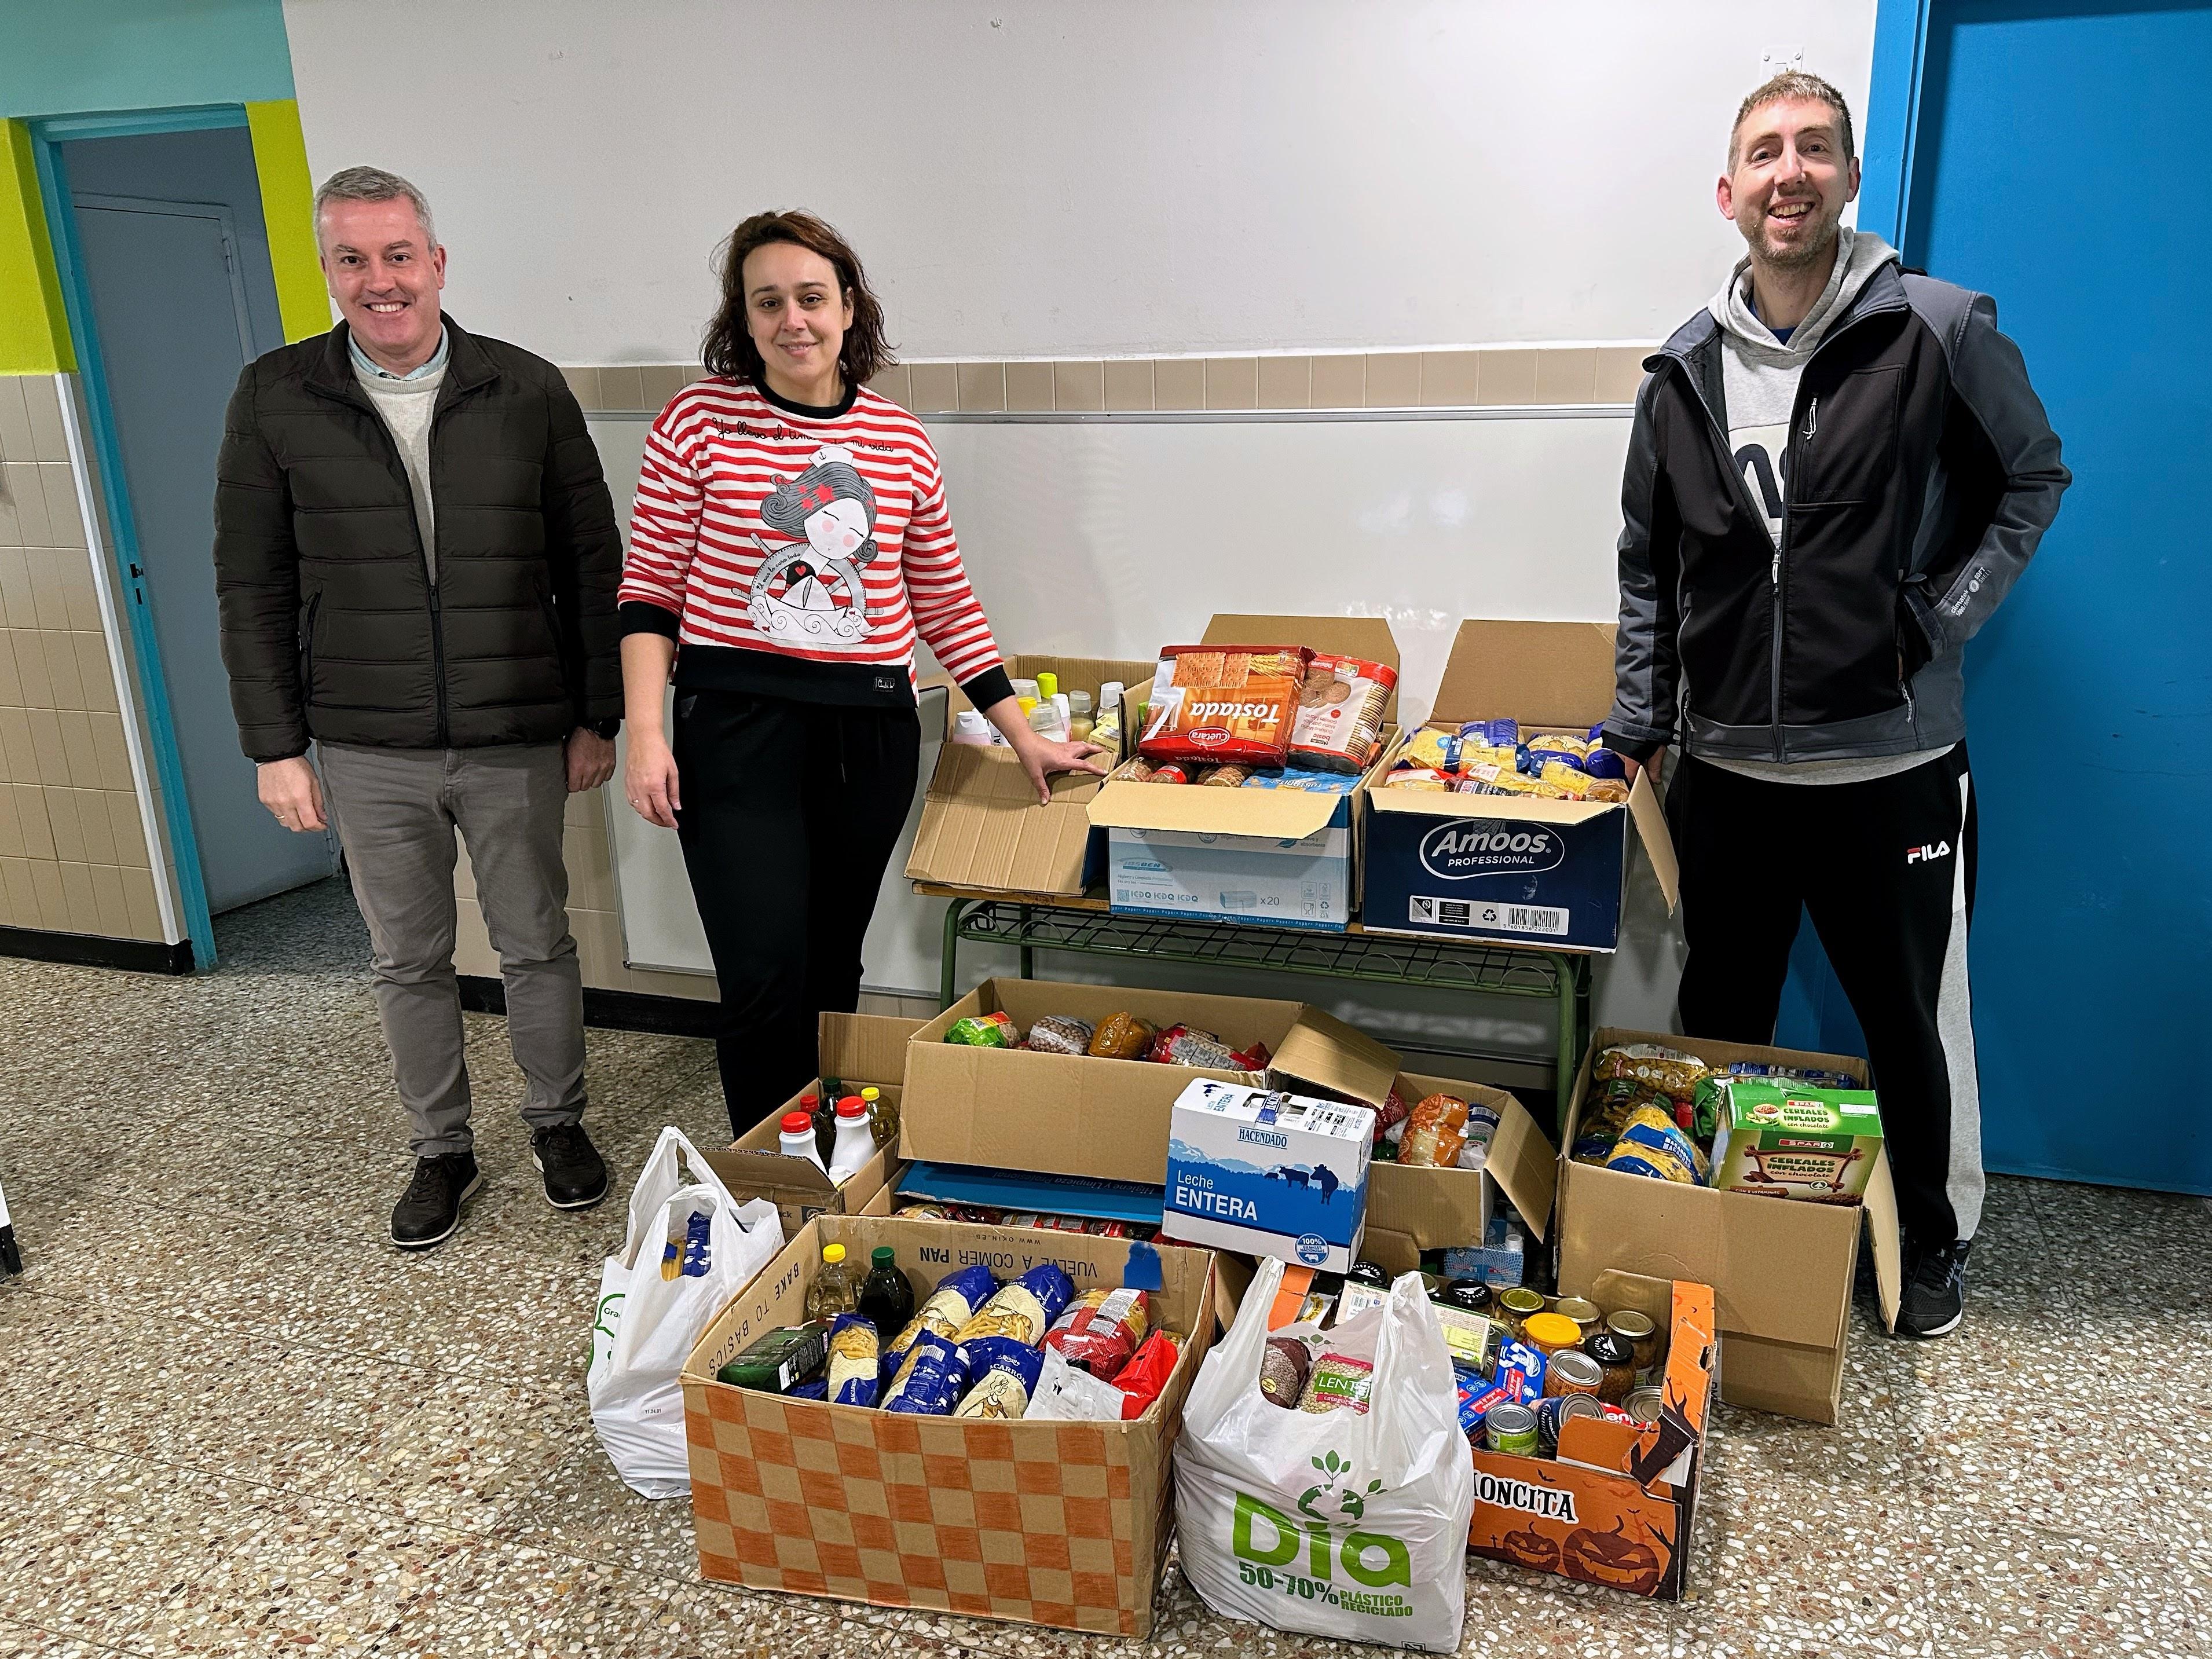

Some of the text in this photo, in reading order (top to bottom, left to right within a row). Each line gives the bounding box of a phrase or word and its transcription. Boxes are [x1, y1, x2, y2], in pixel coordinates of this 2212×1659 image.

[773, 424, 785, 441] el
[869, 442, 894, 452] vida
[1974, 567, 1986, 580] SOFT
[1979, 569, 1992, 584] SHELL
[1190, 702, 1280, 723] Tostada
[1191, 731, 1228, 741] Cuétara
[1313, 733, 1331, 741] basic
[1431, 830, 1550, 857] Amoos
[1907, 841, 1950, 864] FILA
[1448, 855, 1535, 867] PROFESSIONAL
[1260, 896, 1280, 906] x20
[1214, 1094, 1235, 1112] ENTERA
[1239, 1129, 1287, 1148] HACENDADO
[1767, 1163, 1834, 1173] INFLADOS
[1770, 1157, 1835, 1166] CEREALES
[993, 1171, 1053, 1185] Profesional
[1178, 1170, 1214, 1189] Leche
[1788, 1170, 1831, 1178] chocolate
[1054, 1178, 1103, 1189] Limpieza
[1111, 1184, 1155, 1195] Higiene
[1175, 1186, 1258, 1221] ENTERA
[1302, 1237, 1322, 1246] 100%
[920, 1247, 949, 1264] PAN
[959, 1250, 1013, 1269] COMER
[1022, 1256, 1032, 1270] A
[709, 1262, 799, 1376] BAKE TO BASICS
[990, 1364, 1027, 1385] ACARRÓN
[1239, 1562, 1339, 1605] 50-70%
[1340, 1591, 1403, 1606] PLÁSTICO
[1341, 1602, 1413, 1617] RECICLADO
